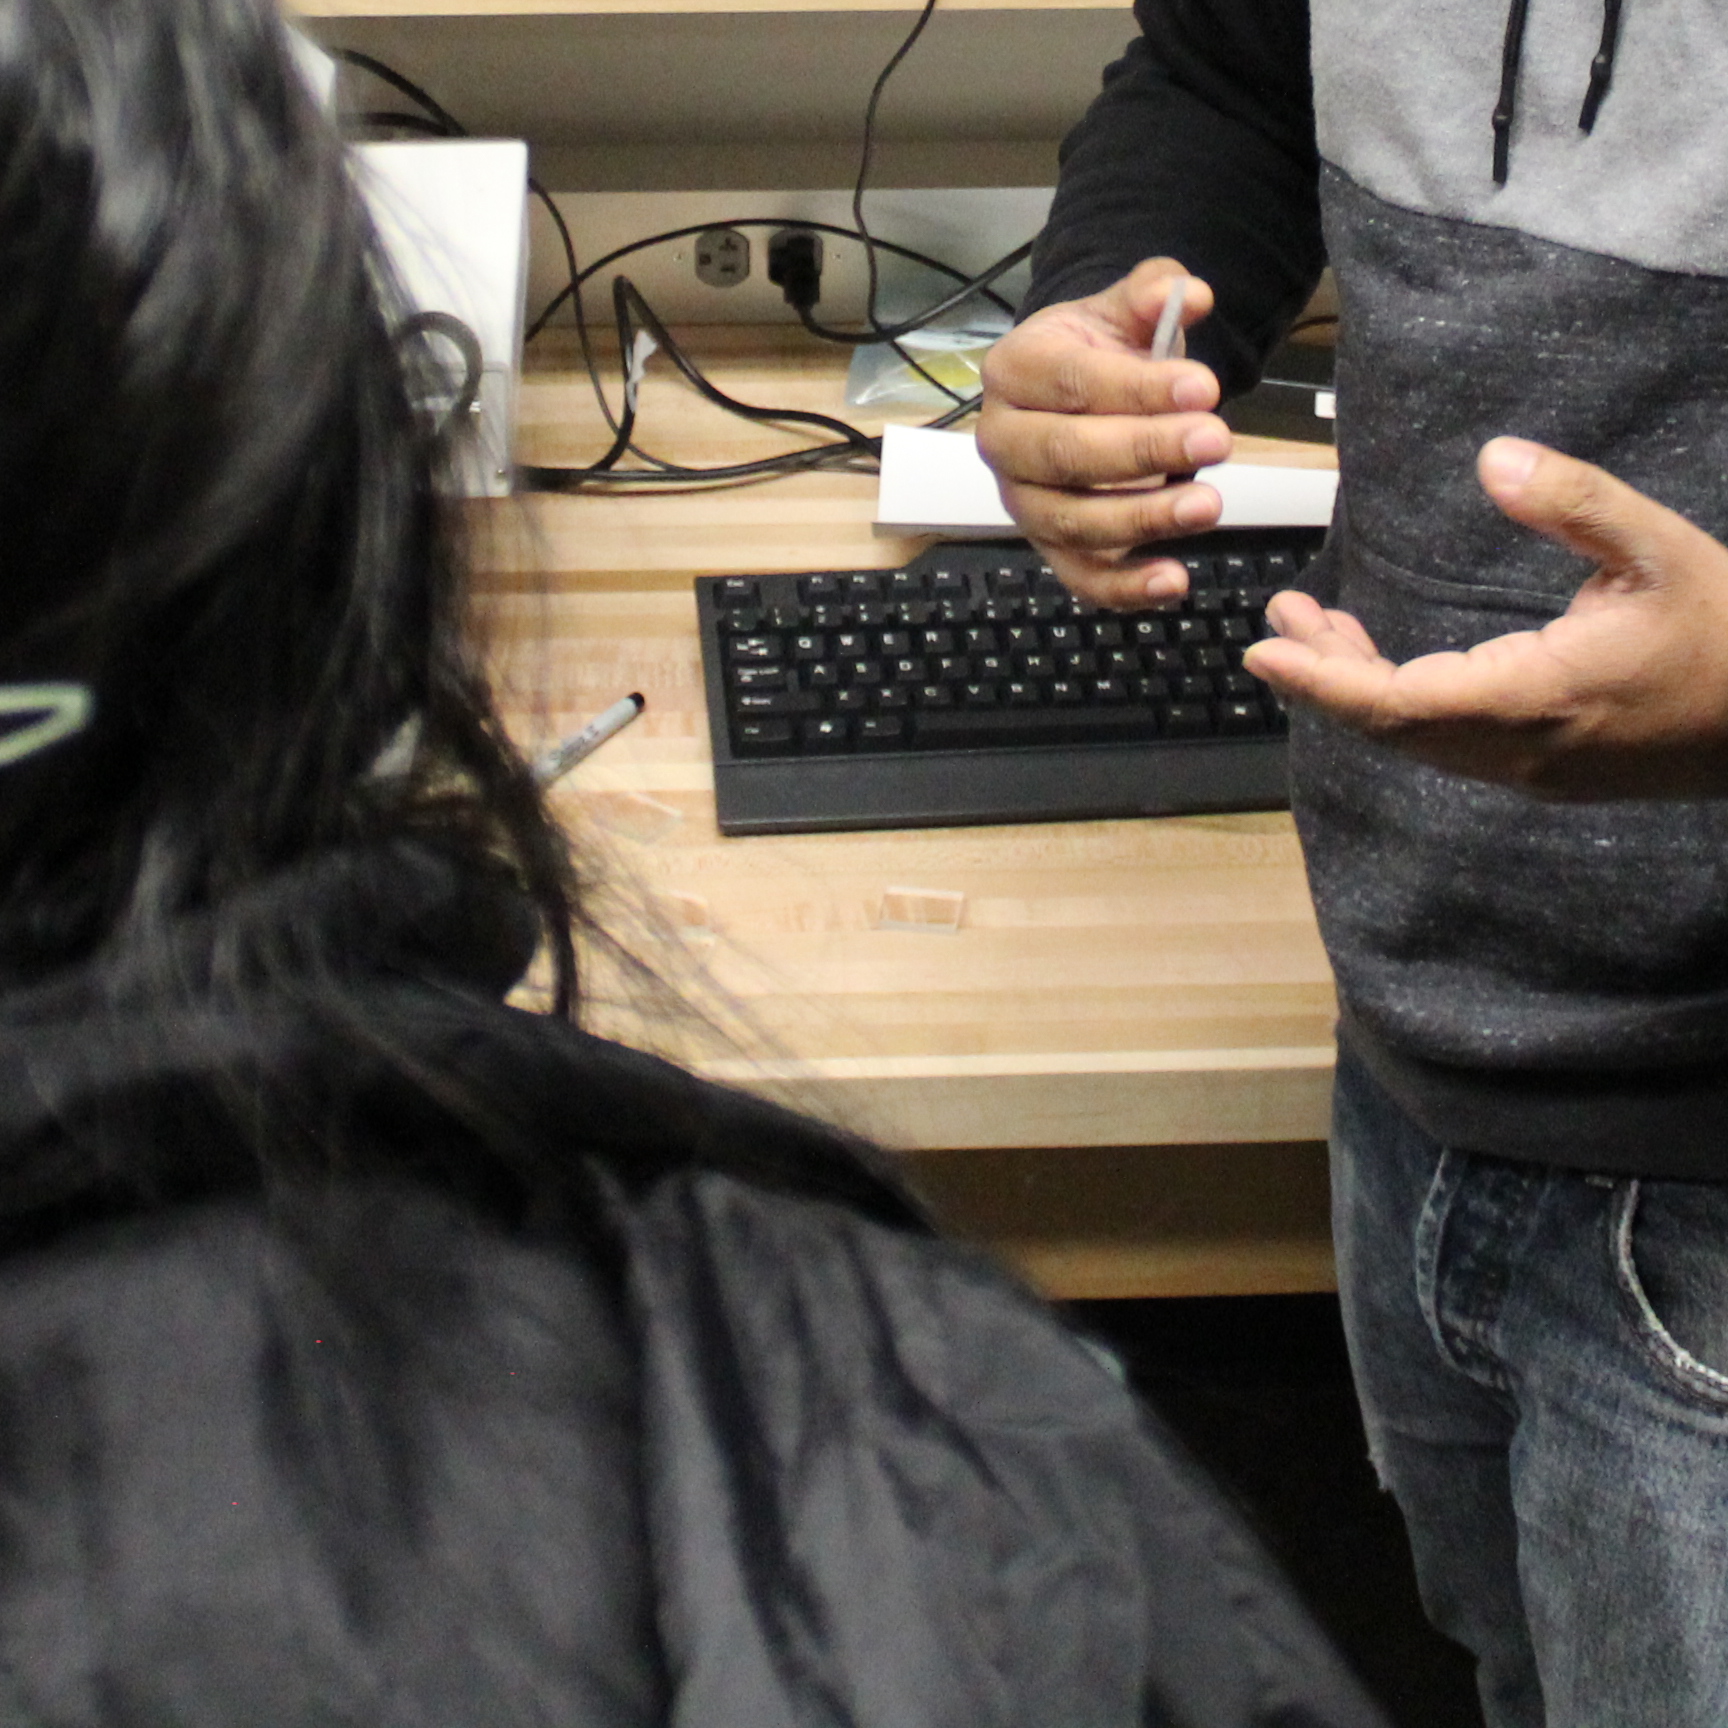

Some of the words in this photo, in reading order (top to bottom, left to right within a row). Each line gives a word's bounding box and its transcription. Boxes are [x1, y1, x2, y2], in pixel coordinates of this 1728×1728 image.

[1010, 628, 1022, 639] Y
[1052, 627, 1066, 638] U
[1138, 622, 1152, 633] O
